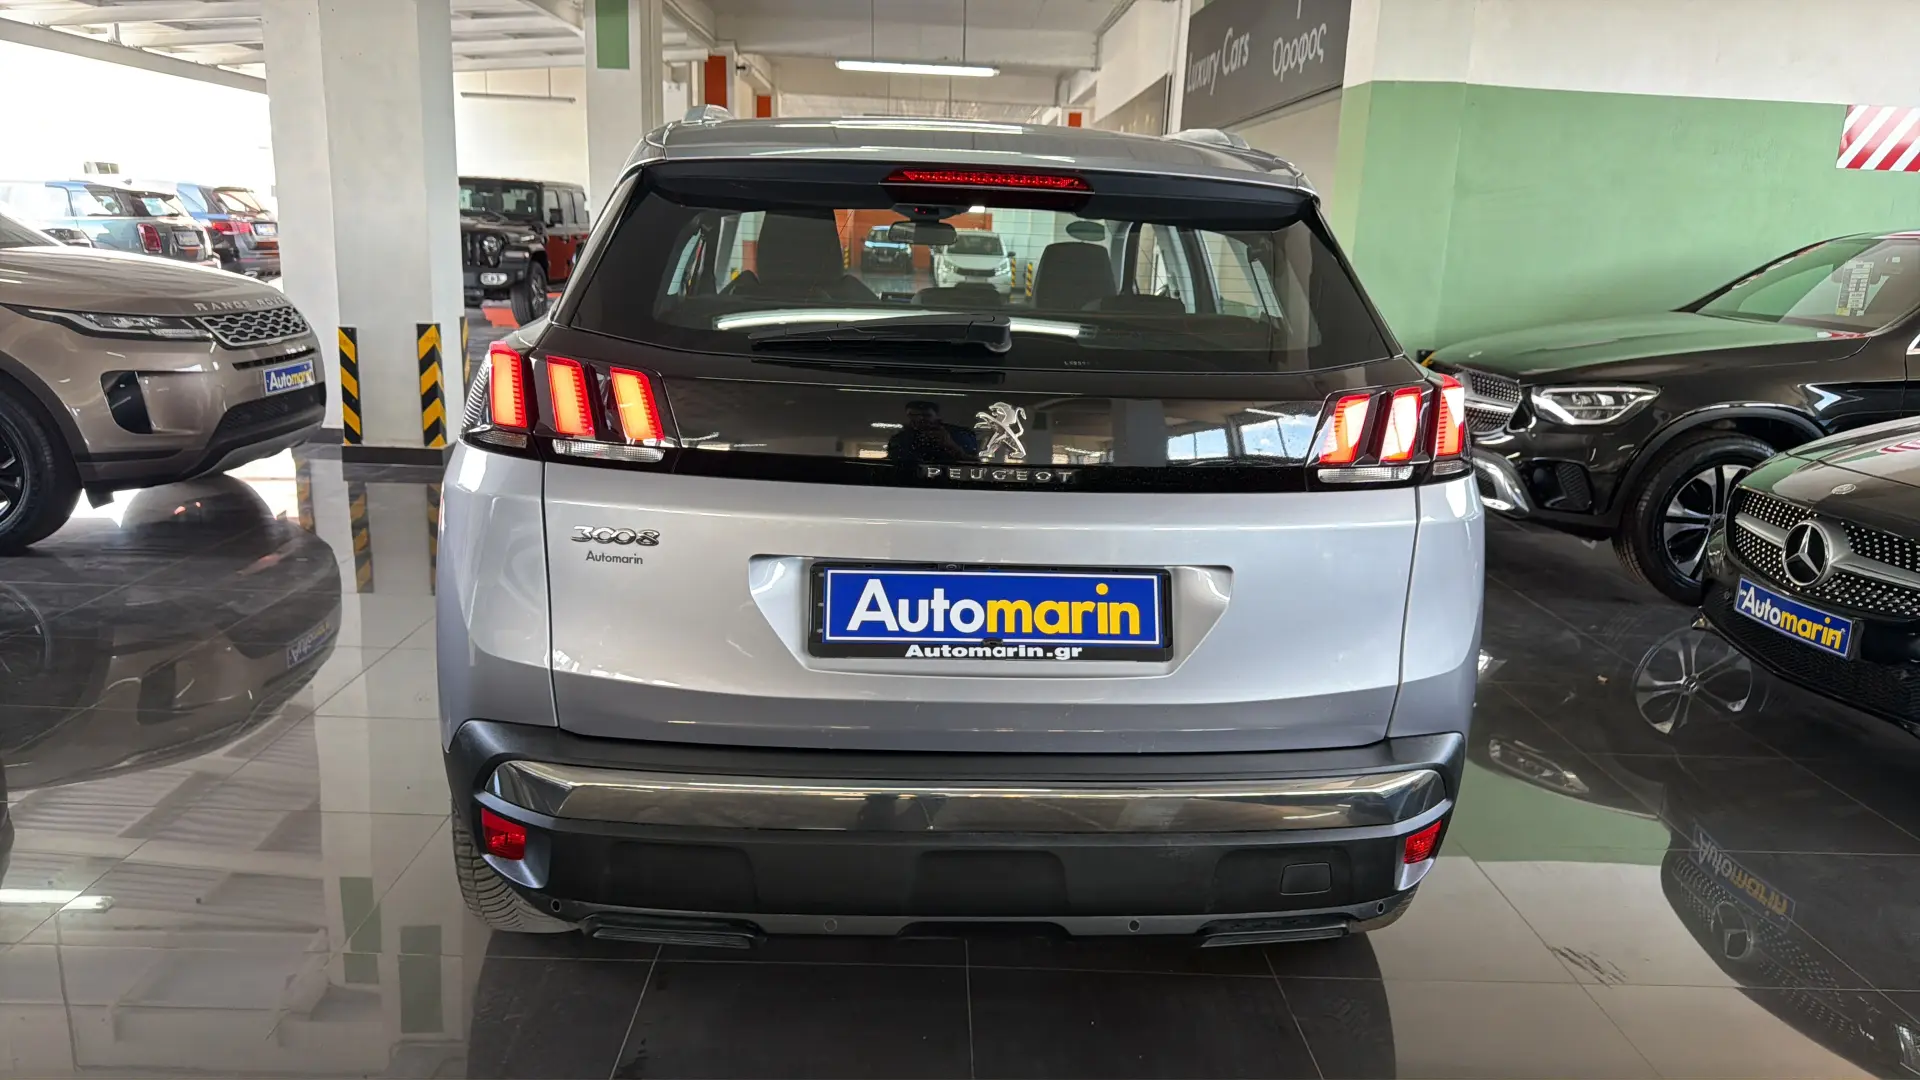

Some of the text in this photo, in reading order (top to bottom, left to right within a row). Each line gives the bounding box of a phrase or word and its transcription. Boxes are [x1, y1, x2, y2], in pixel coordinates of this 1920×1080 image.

[1186, 27, 1250, 96] Luxury Cars
[193, 300, 252, 311] RANGE
[927, 467, 1072, 482] PEUGEOT
[571, 525, 660, 546] 3008
[586, 550, 643, 564] Automarin
[846, 578, 1140, 635] Automarin
[1741, 586, 1843, 650] Automarin
[905, 644, 1083, 661] Automarin.gr
